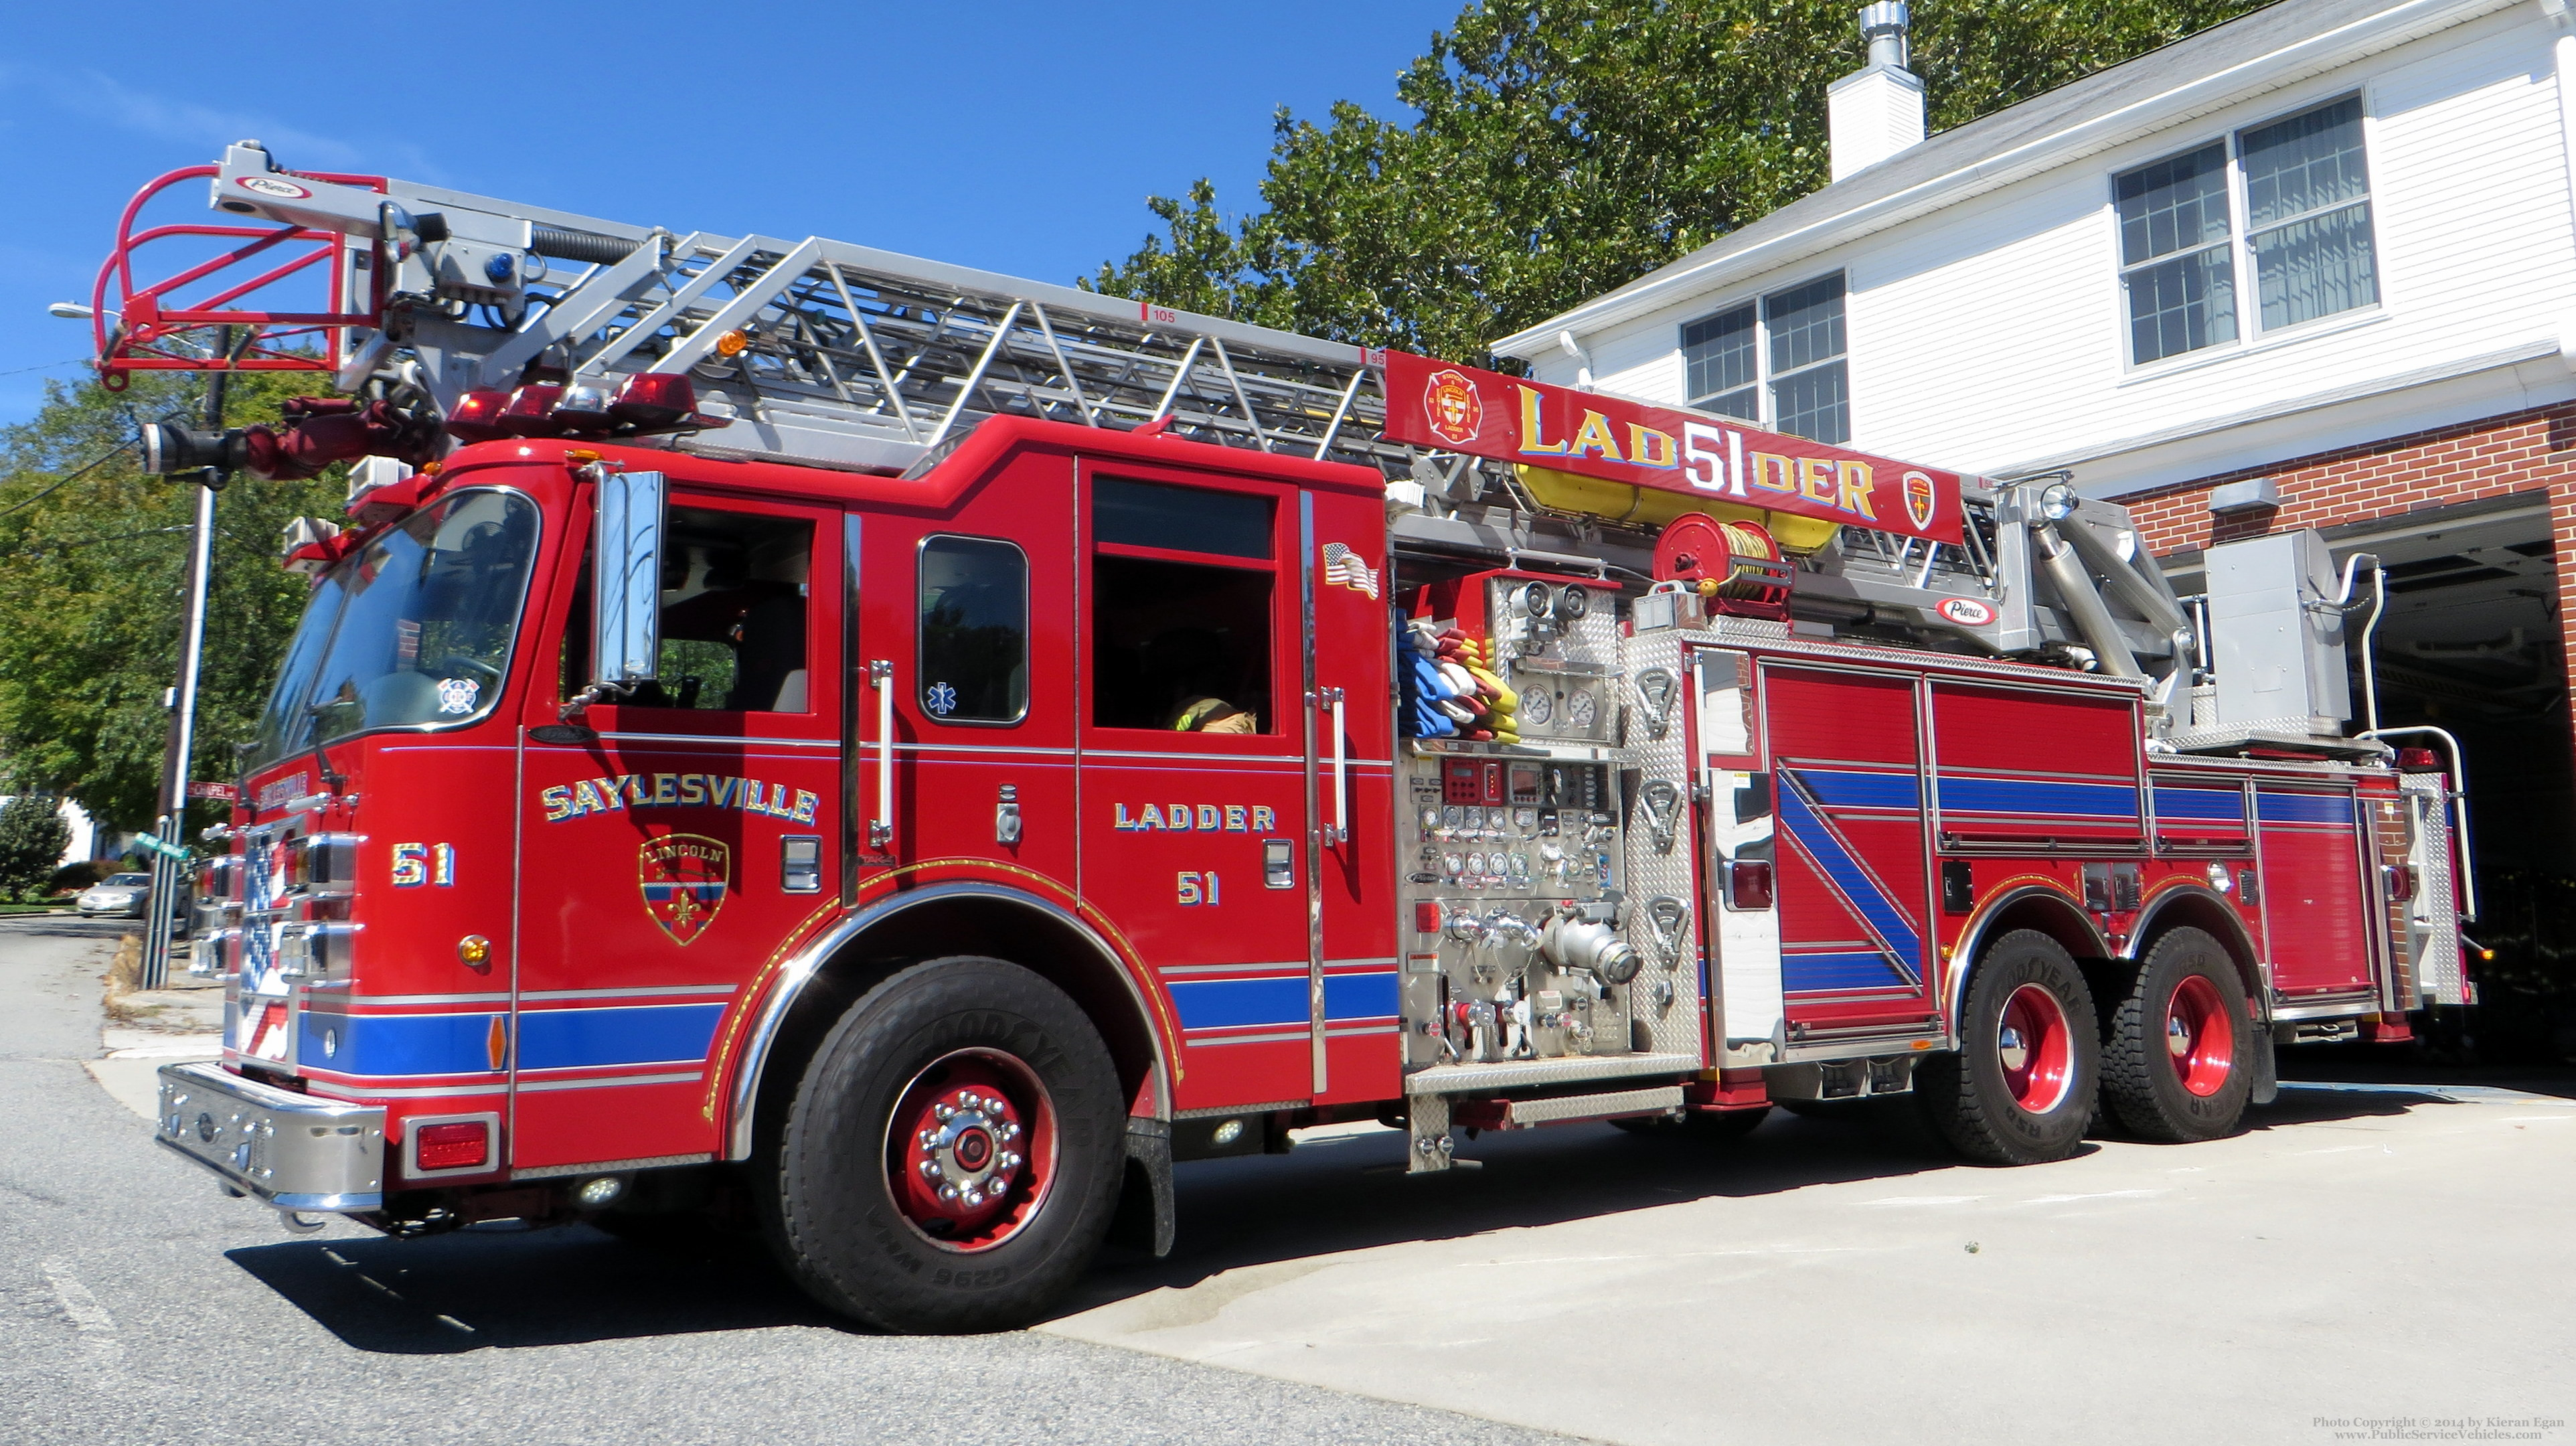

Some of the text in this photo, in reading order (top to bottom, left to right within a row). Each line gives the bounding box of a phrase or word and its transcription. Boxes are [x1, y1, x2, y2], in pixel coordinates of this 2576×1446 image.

[1153, 310, 1175, 323] 105
[1371, 353, 1384, 365] 95
[1442, 374, 1464, 384] STATION
[1443, 387, 1463, 396] LINCOLN
[1445, 424, 1463, 433] LADDER
[1683, 420, 1749, 497] 51
[1950, 601, 1982, 619] Pierce
[193, 783, 226, 797] CHAPEL
[542, 773, 819, 826] SAYLESVILLE
[1115, 803, 1275, 833] LADDER
[645, 844, 724, 864] LINCOLN
[392, 842, 455, 888] 51
[1178, 872, 1219, 906] 51
